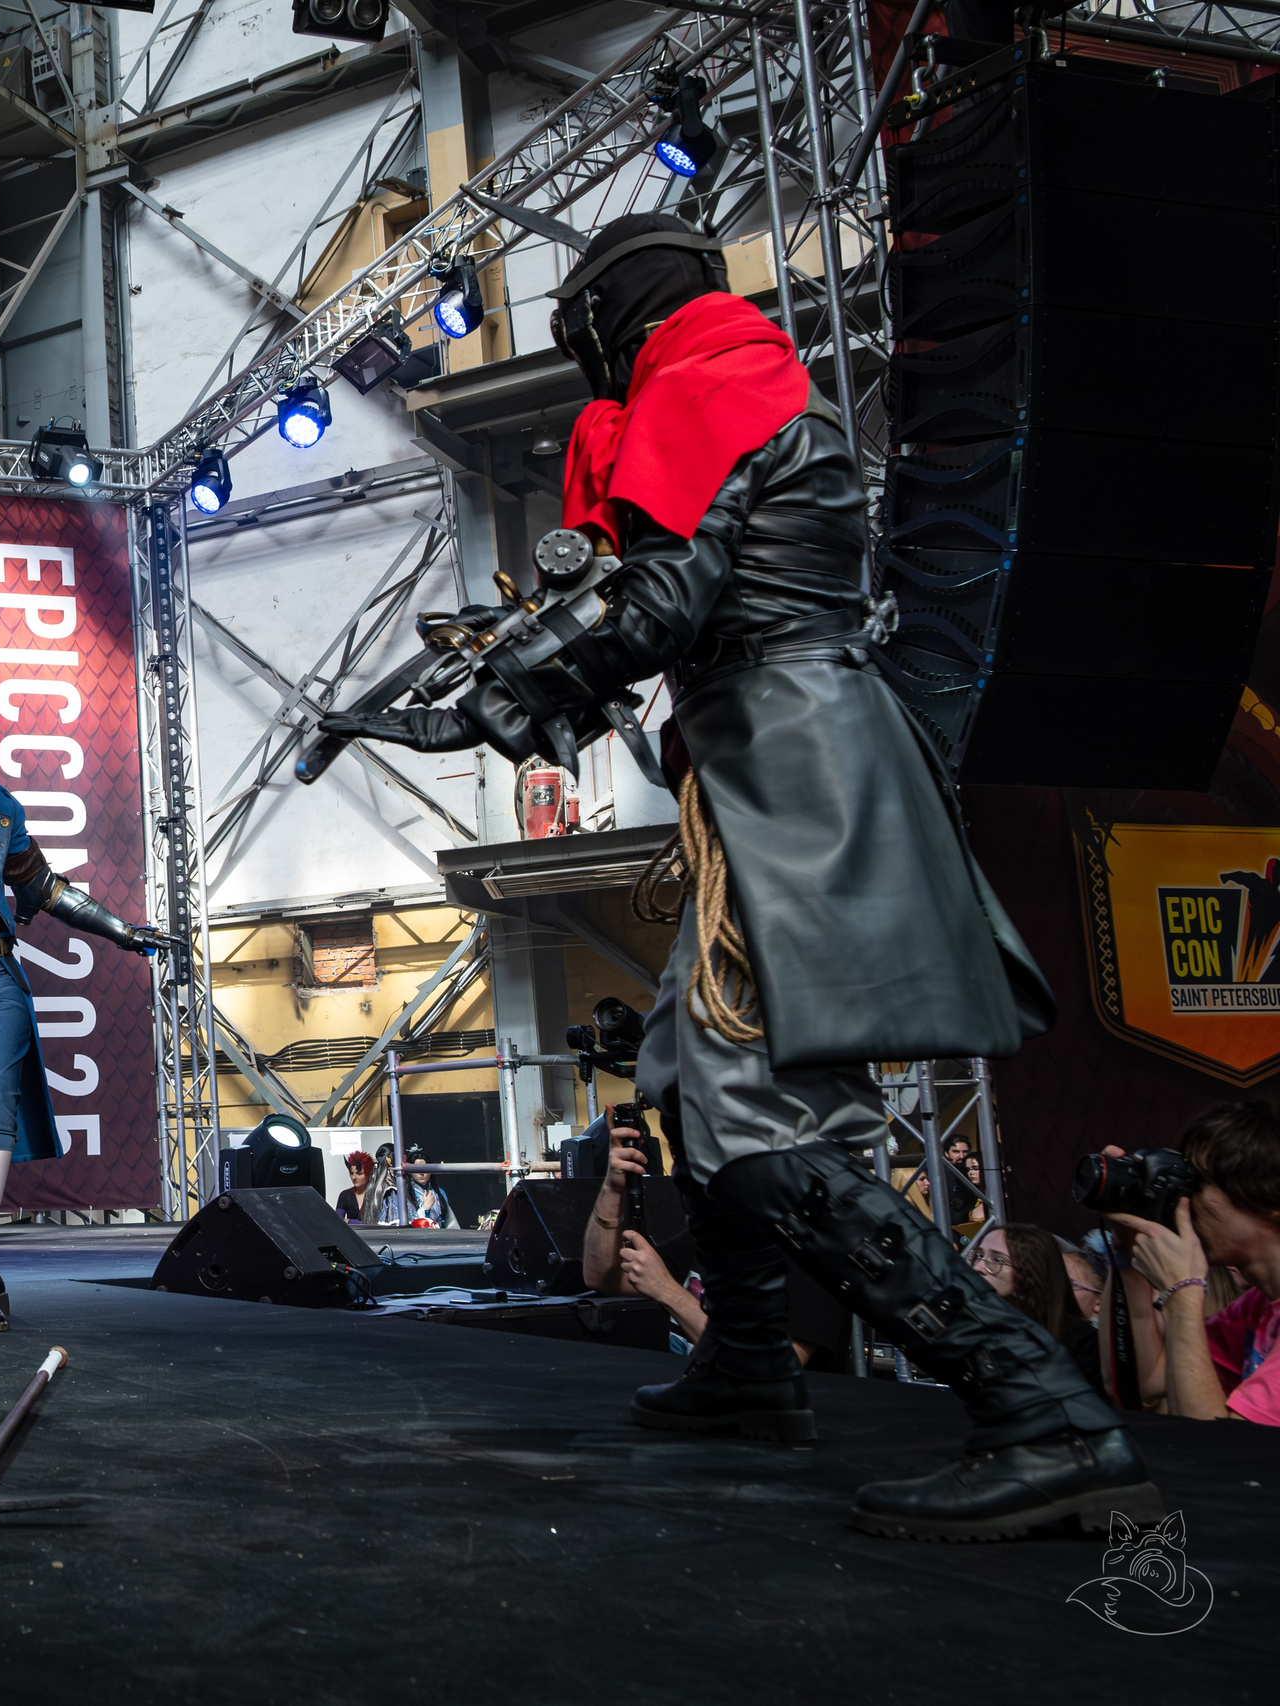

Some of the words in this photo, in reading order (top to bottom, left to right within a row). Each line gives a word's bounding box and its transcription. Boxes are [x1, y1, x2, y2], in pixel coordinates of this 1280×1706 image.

[1165, 896, 1222, 934] EPIC
[1171, 939, 1222, 977] CON
[1171, 988, 1208, 1007] SAINT
[1211, 987, 1280, 1007] PETERSBU
